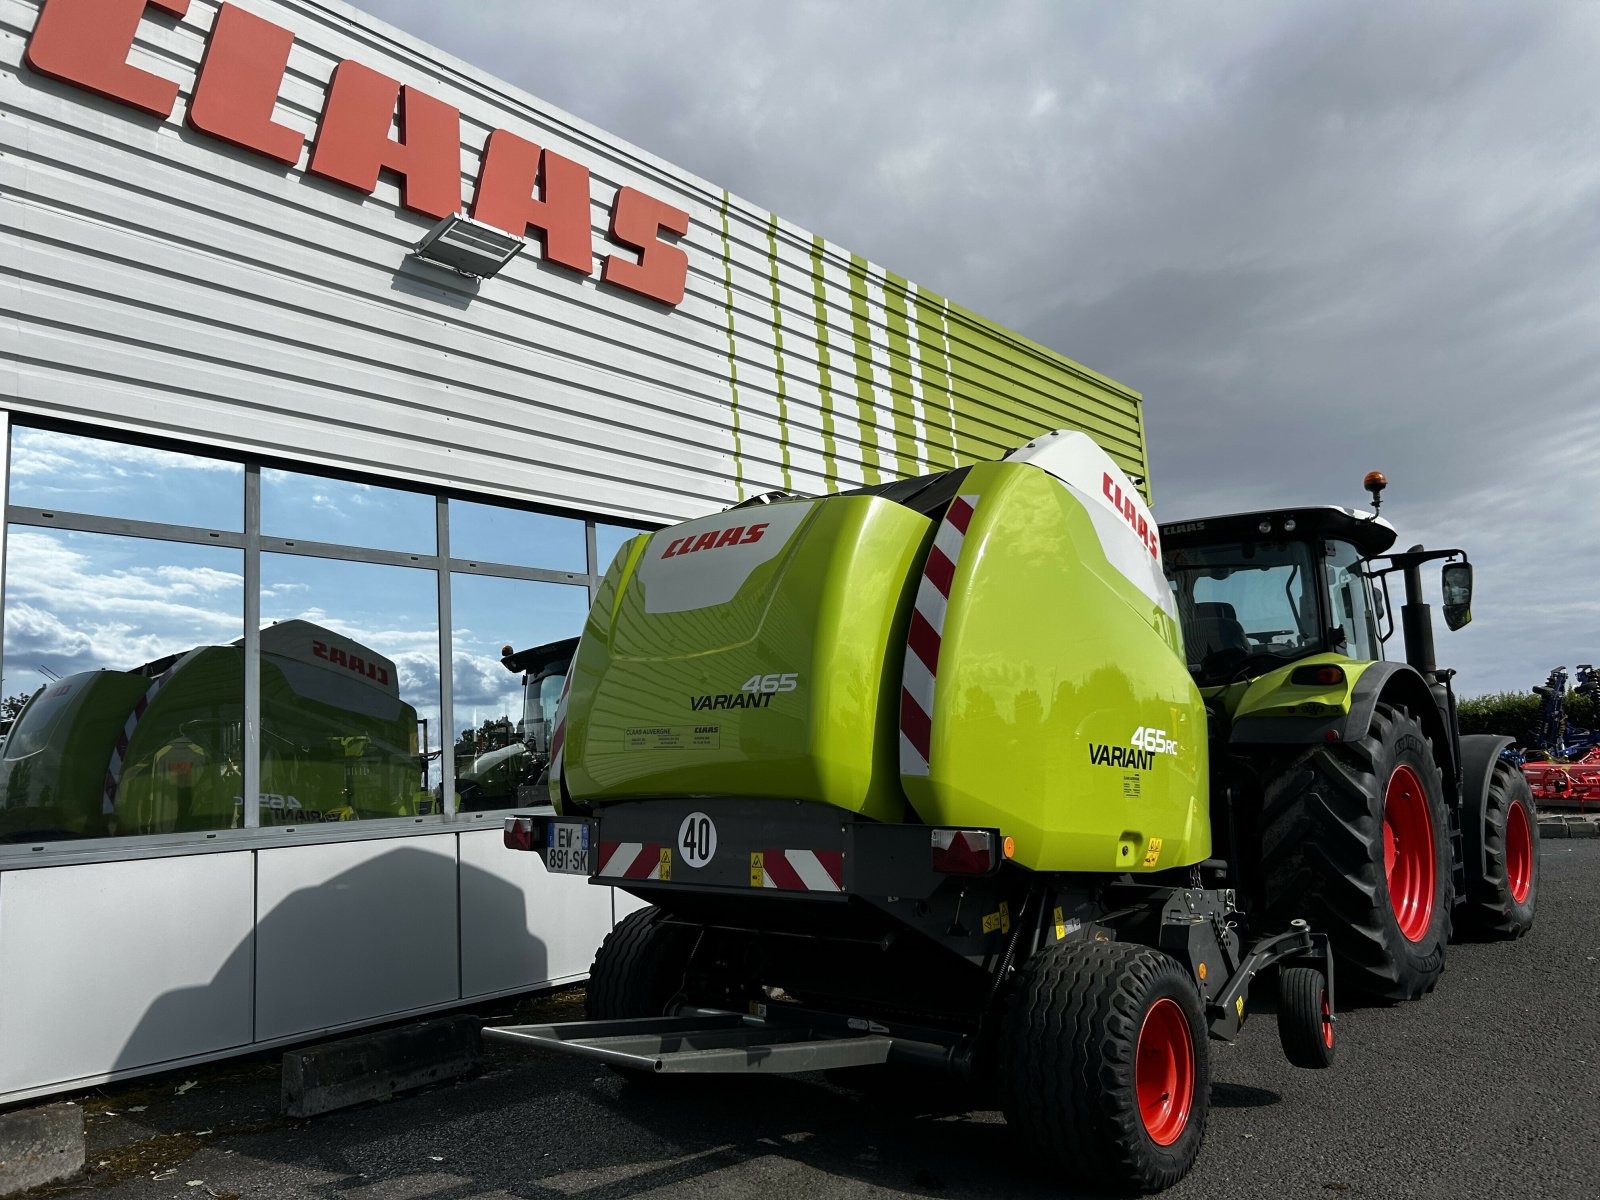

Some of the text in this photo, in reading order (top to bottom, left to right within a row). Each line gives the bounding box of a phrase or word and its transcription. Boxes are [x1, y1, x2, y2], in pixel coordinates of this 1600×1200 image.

[25, 0, 690, 306] CLAAS
[1102, 471, 1158, 560] CLAAS
[1163, 521, 1205, 536] CLAAS
[661, 523, 770, 559] CLAAS
[741, 673, 799, 694] 465
[690, 691, 775, 711] VARIANT
[694, 726, 719, 734] CLAAS
[1088, 743, 1156, 770] VARIANT
[683, 817, 710, 861] 40
